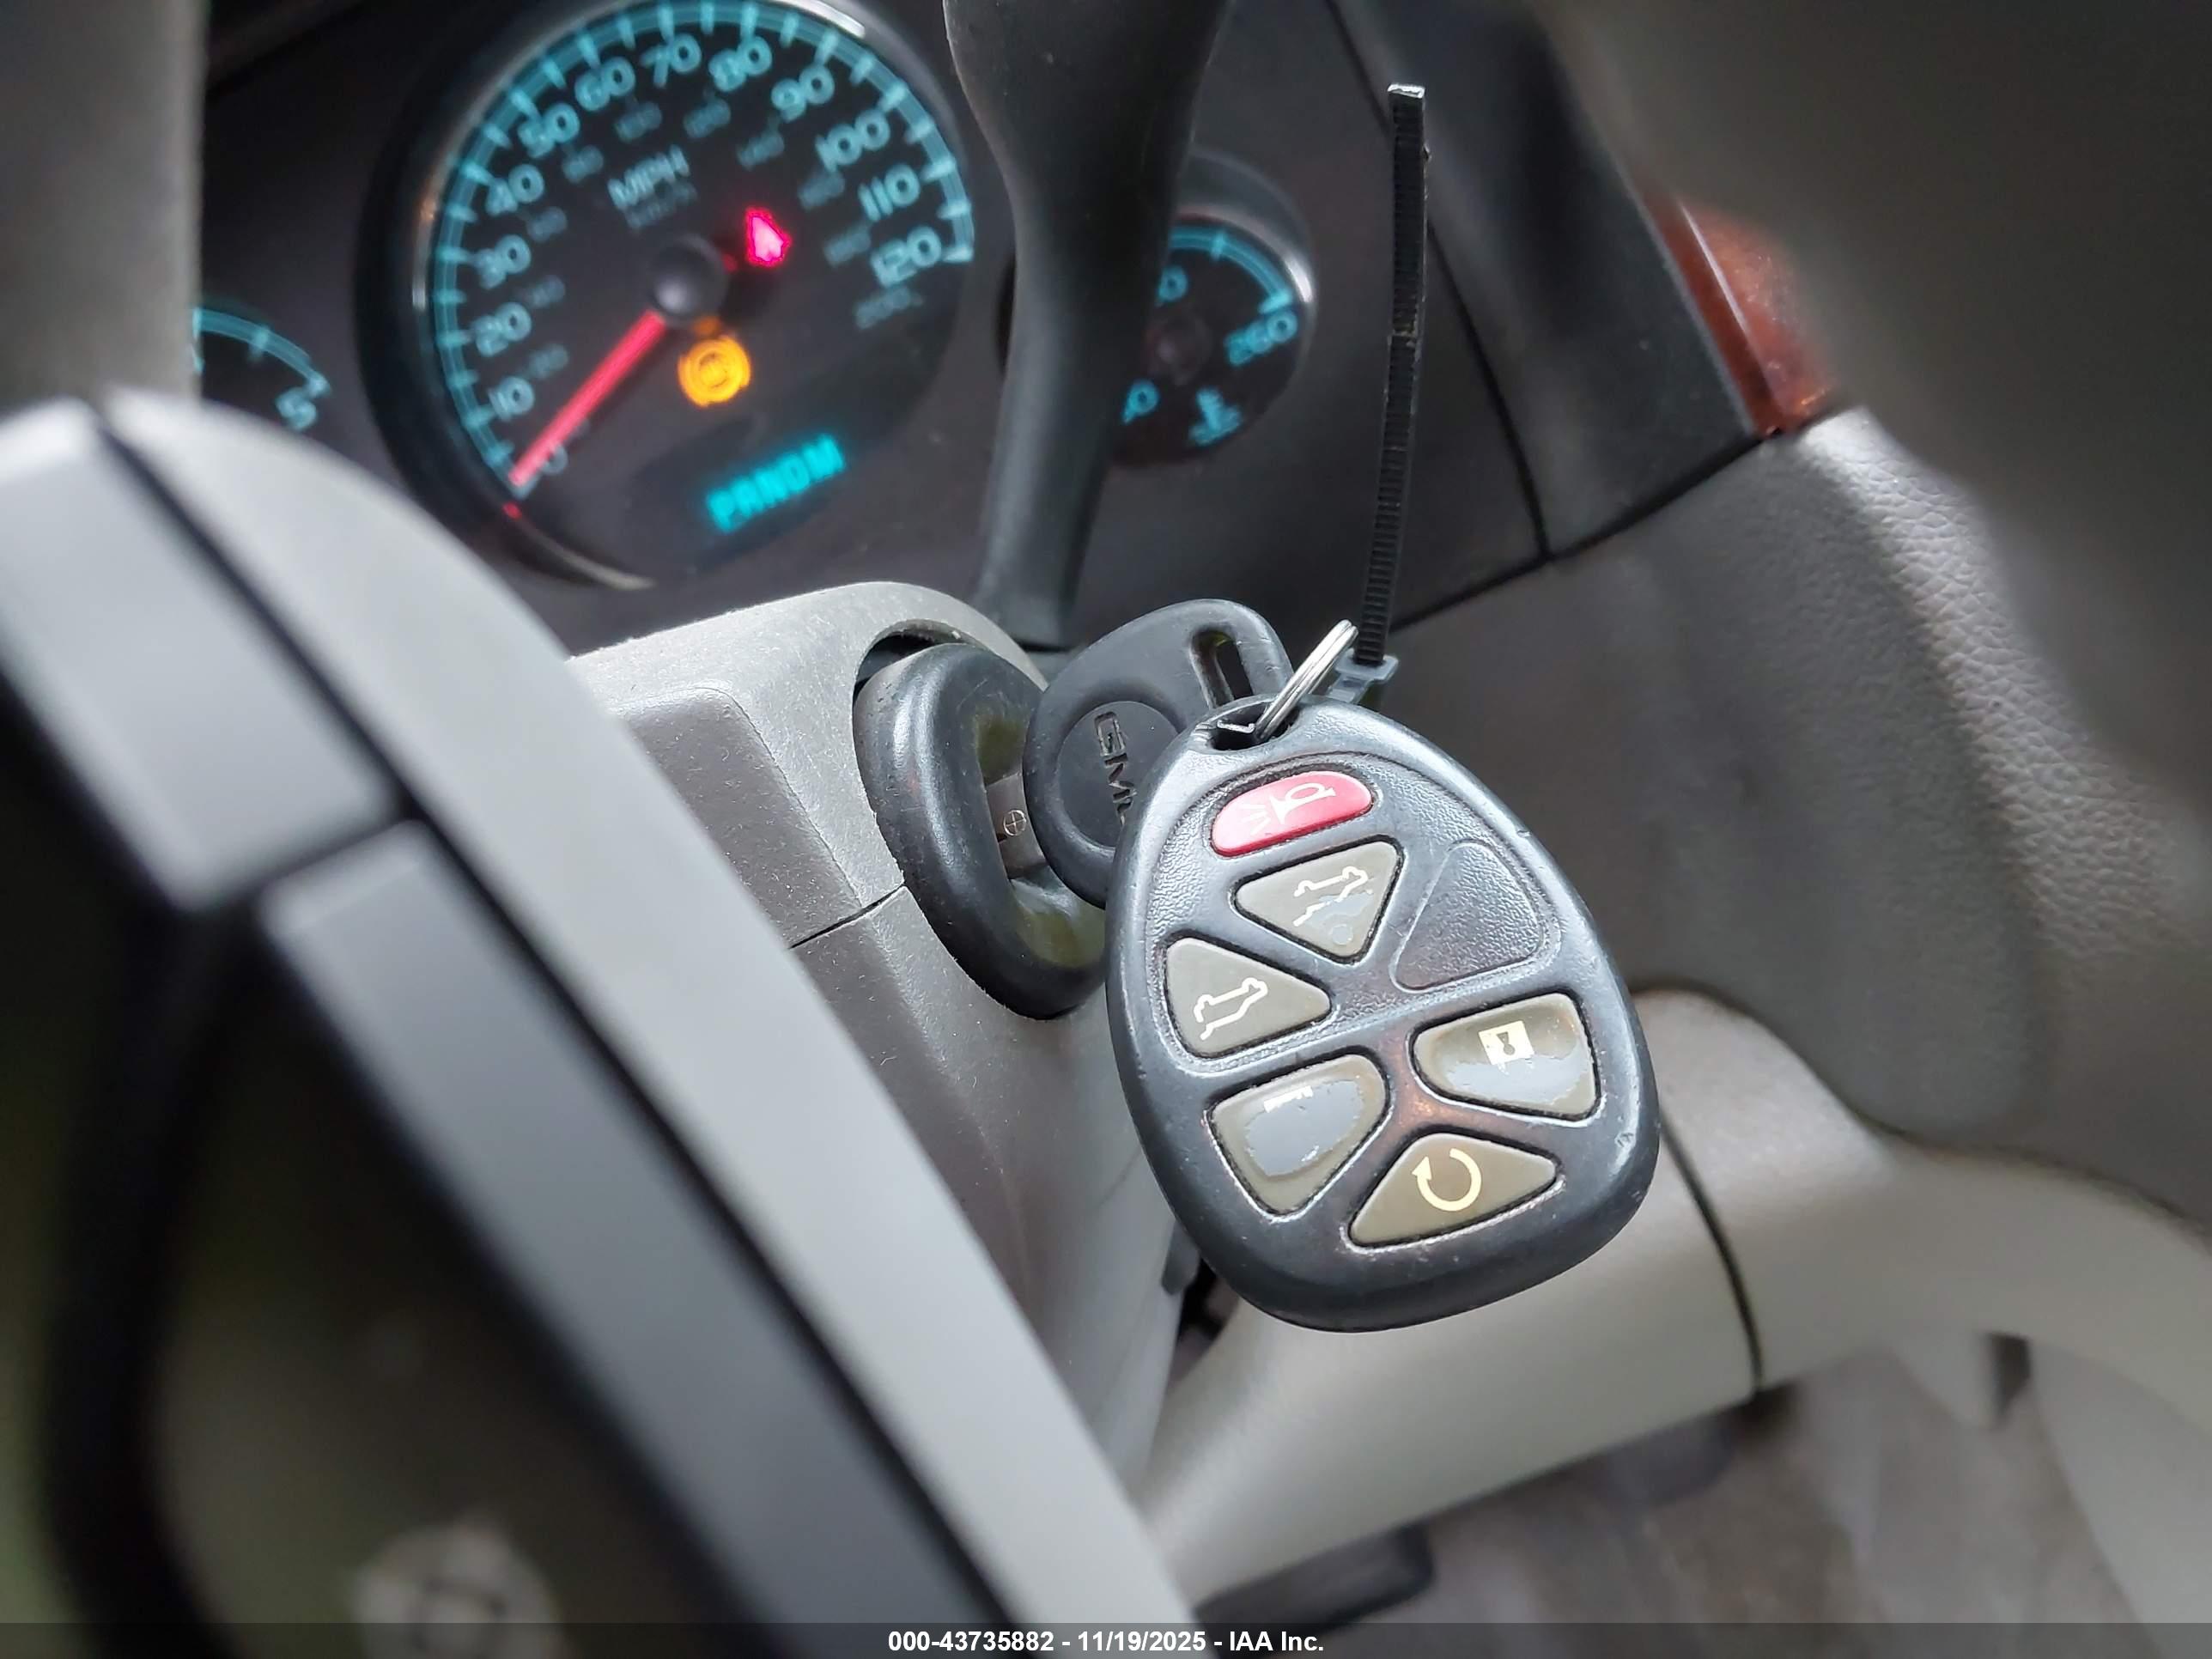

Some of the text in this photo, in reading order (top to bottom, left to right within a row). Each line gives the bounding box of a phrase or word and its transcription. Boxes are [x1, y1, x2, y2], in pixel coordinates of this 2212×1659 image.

[574, 57, 635, 111] 60
[641, 33, 702, 88] 70
[708, 34, 772, 92] 80
[771, 63, 835, 123] 90
[518, 102, 580, 158] 50
[815, 106, 890, 172] 100
[486, 164, 544, 216] 40
[607, 144, 690, 210] MPH
[859, 164, 920, 222] 110
[474, 234, 532, 289] 30
[871, 226, 941, 287] 120
[471, 302, 532, 357] 20
[487, 376, 535, 422] 10
